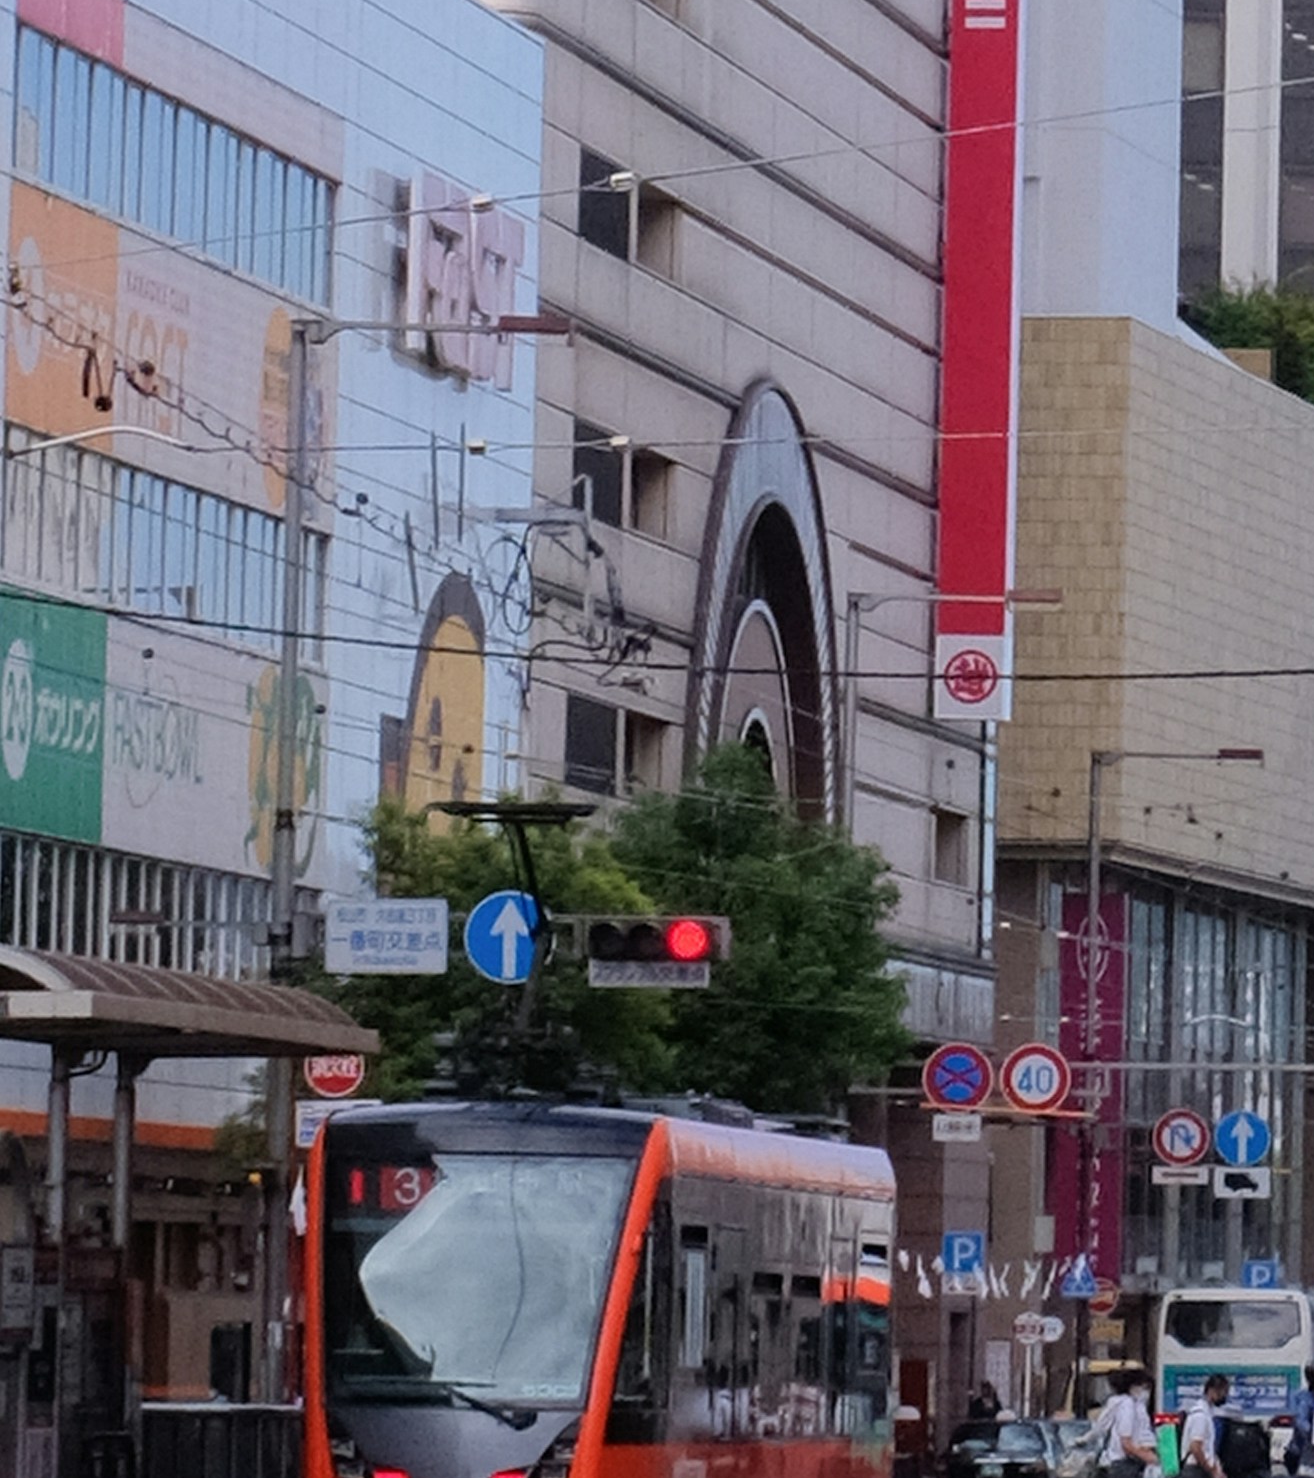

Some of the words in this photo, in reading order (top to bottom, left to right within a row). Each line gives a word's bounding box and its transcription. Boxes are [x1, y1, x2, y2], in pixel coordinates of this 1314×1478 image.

[35, 687, 101, 754] ボウリング
[1017, 1066, 1053, 1095] 40
[394, 1167, 421, 1205] 3
[953, 1237, 976, 1269] P
[1251, 1265, 1271, 1285] P
